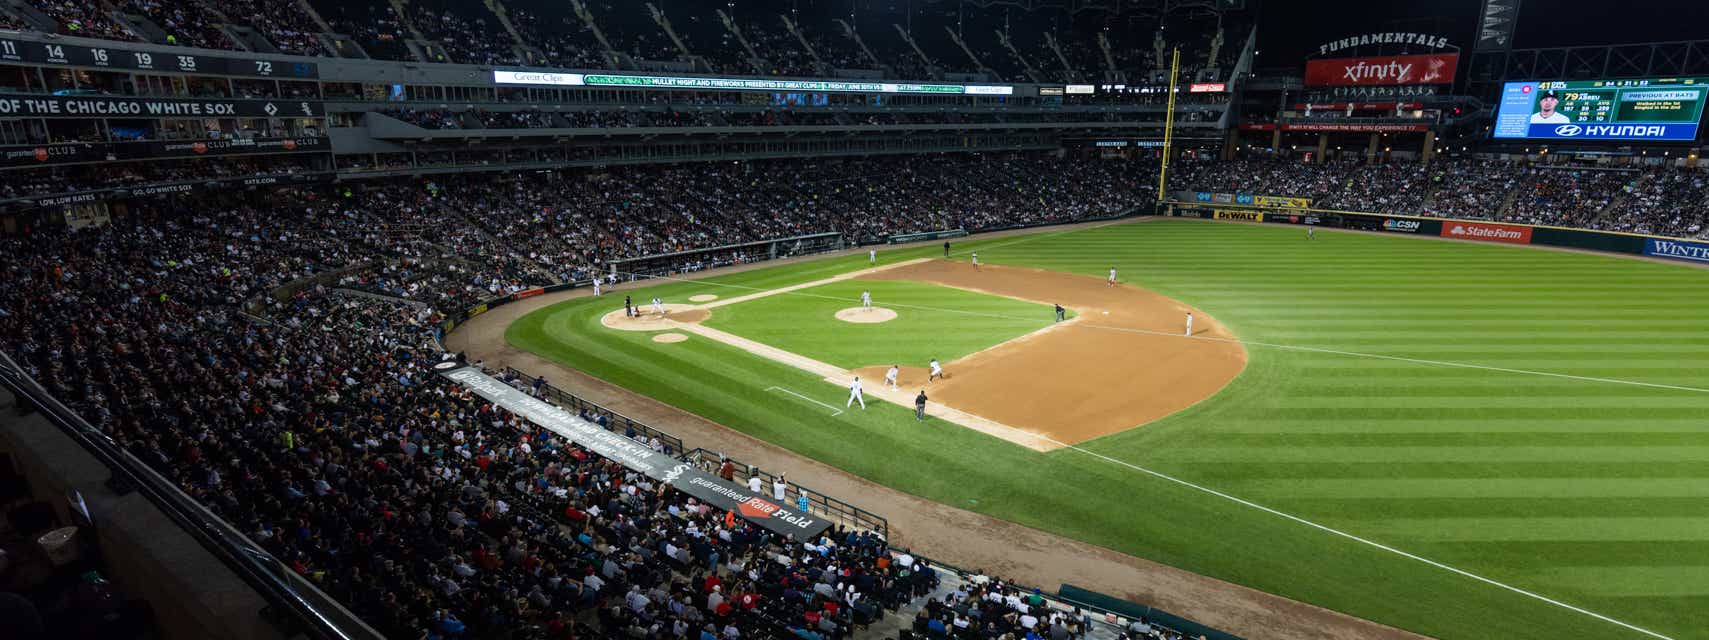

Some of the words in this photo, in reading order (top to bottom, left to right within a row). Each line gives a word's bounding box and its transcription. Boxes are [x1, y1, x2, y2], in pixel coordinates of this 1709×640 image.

[1, 40, 16, 54] 11
[1320, 32, 1448, 55] FUNDAMENTALS
[45, 44, 65, 58] 14
[91, 48, 108, 62] 16
[134, 52, 152, 65] 19
[178, 56, 196, 67] 35
[256, 61, 272, 72] 72
[1344, 60, 1413, 82] xfinity
[514, 73, 540, 81] Great
[677, 78, 695, 86] NIGHT
[1564, 93, 1579, 101] 79
[0, 100, 21, 113] OF
[25, 100, 61, 113] THE
[65, 101, 141, 114] CHICAGO
[145, 102, 201, 114] WHITE
[205, 103, 236, 115] SOX
[1585, 126, 1666, 136] HYUNDAI
[296, 136, 319, 145] CLUB
[48, 146, 76, 155] CLUB
[156, 186, 177, 194] WHITE
[1397, 220, 1420, 230] CSN
[690, 477, 752, 503] guaranteed
[747, 498, 774, 513] Rate
[772, 508, 814, 528] Field
